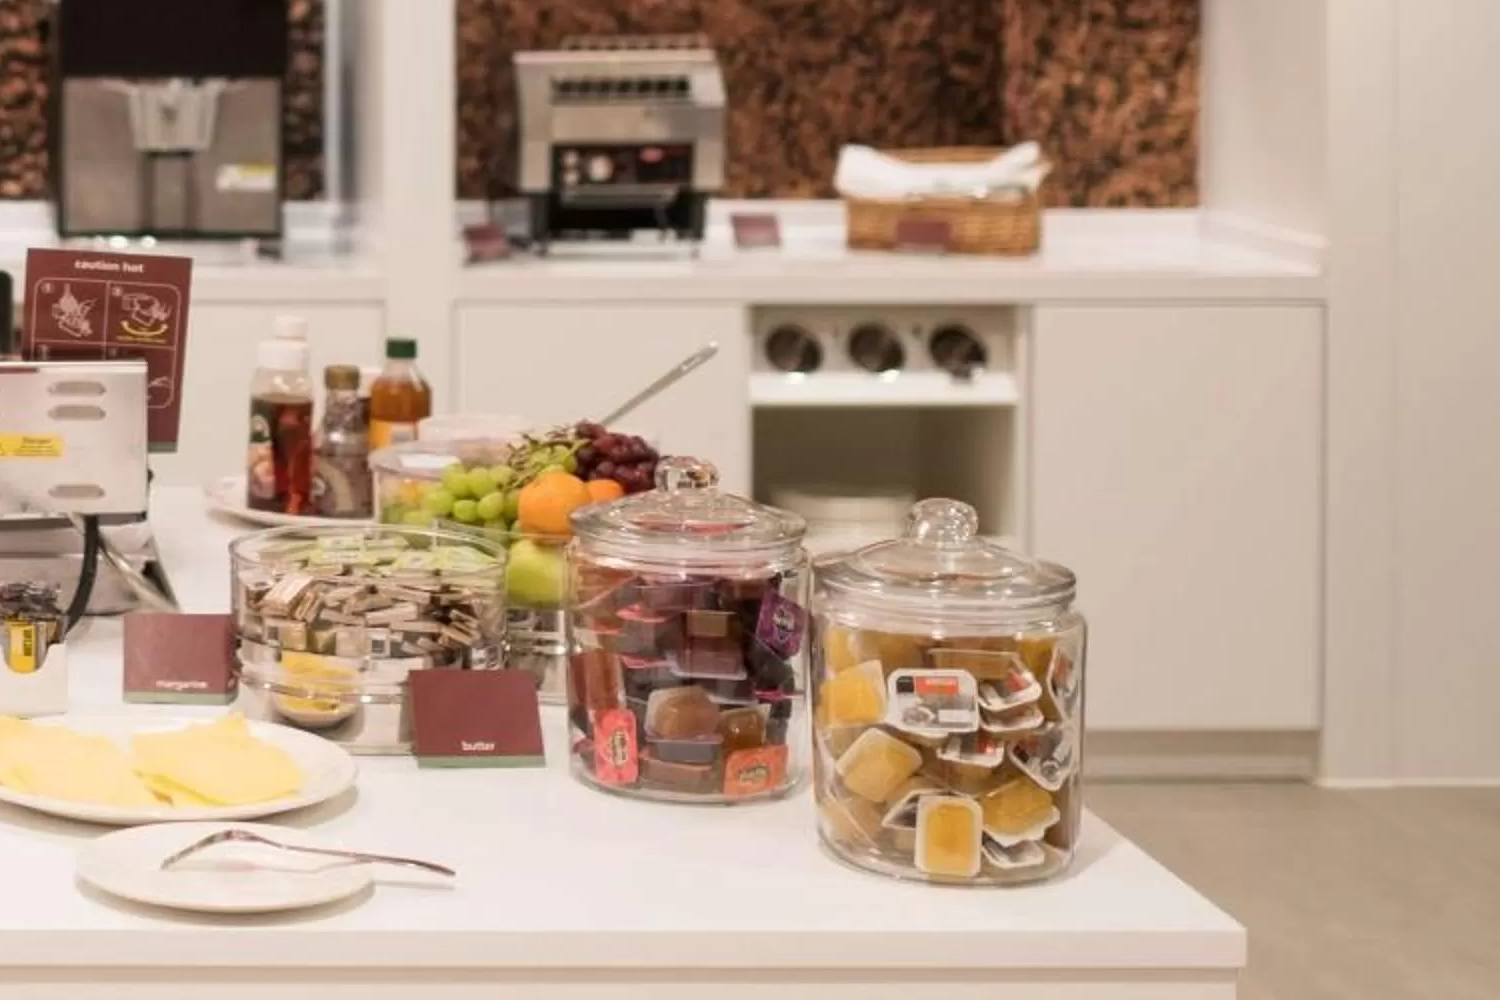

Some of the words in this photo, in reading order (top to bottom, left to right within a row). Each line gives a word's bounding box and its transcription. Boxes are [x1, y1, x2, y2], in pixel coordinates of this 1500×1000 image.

[74, 259, 120, 272] caution
[122, 261, 145, 274] hot
[461, 740, 496, 752] butter
